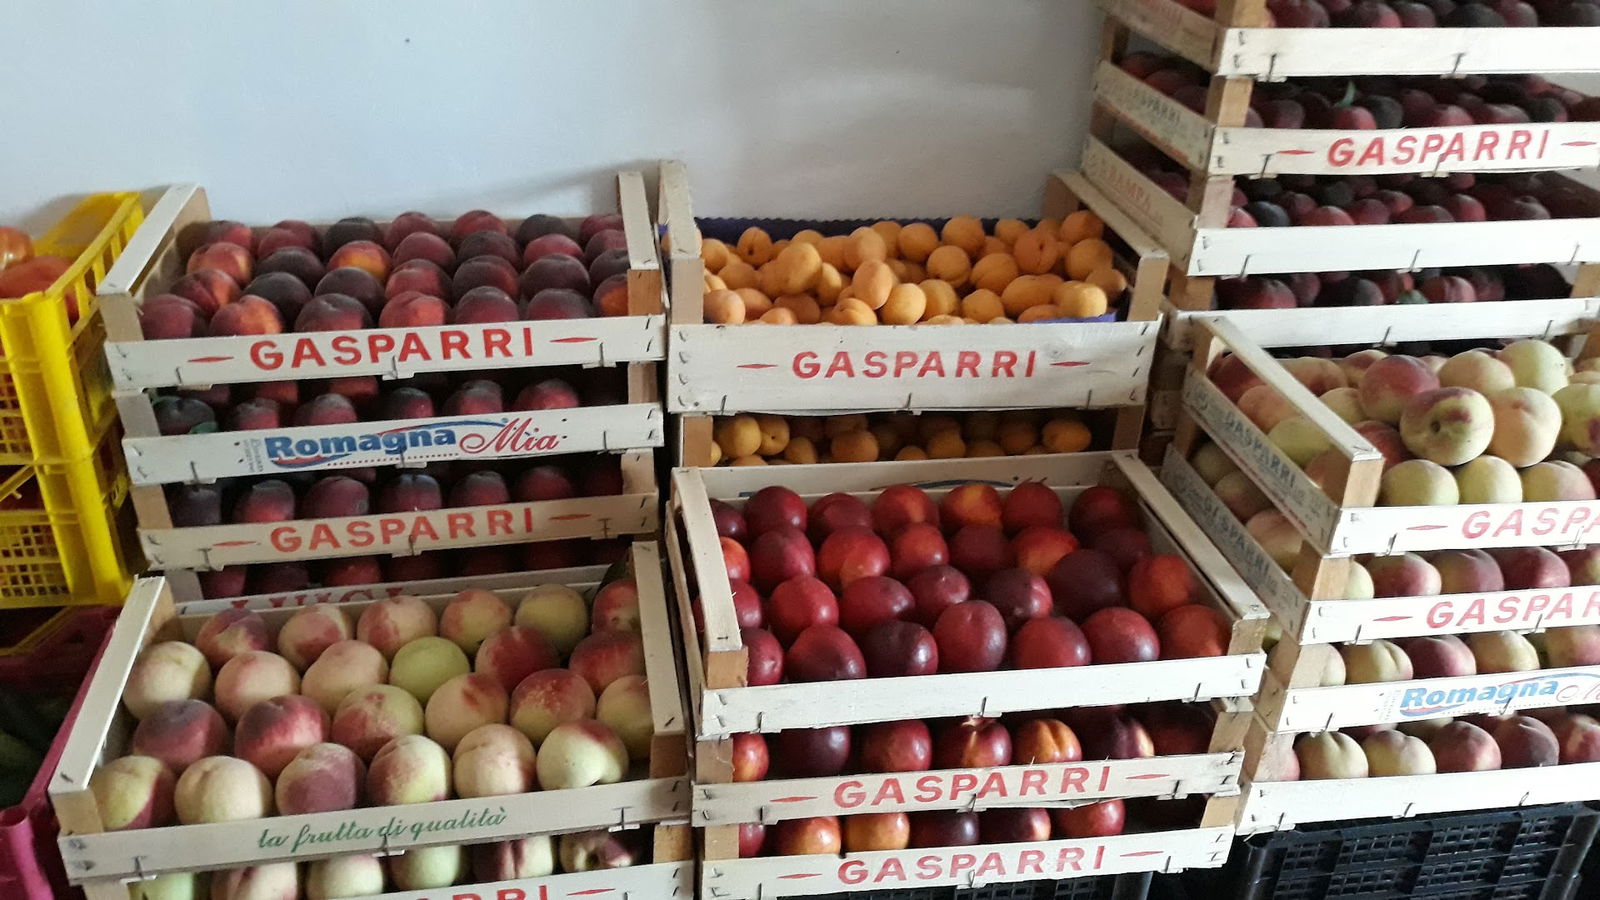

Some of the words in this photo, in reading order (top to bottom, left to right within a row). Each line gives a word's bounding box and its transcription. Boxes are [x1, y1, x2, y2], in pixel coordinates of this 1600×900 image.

[1328, 131, 1549, 167] GASPARRI
[250, 327, 535, 371] GASPARRI
[792, 350, 1037, 379] GASPARRI
[264, 426, 457, 460] Romagna
[459, 417, 561, 454] Mia
[270, 506, 535, 553] GASPARRI
[1400, 680, 1559, 708] Romagna
[834, 766, 1111, 809] GASPARRI
[257, 828, 288, 849] la
[838, 845, 1105, 885] GASPARRI
